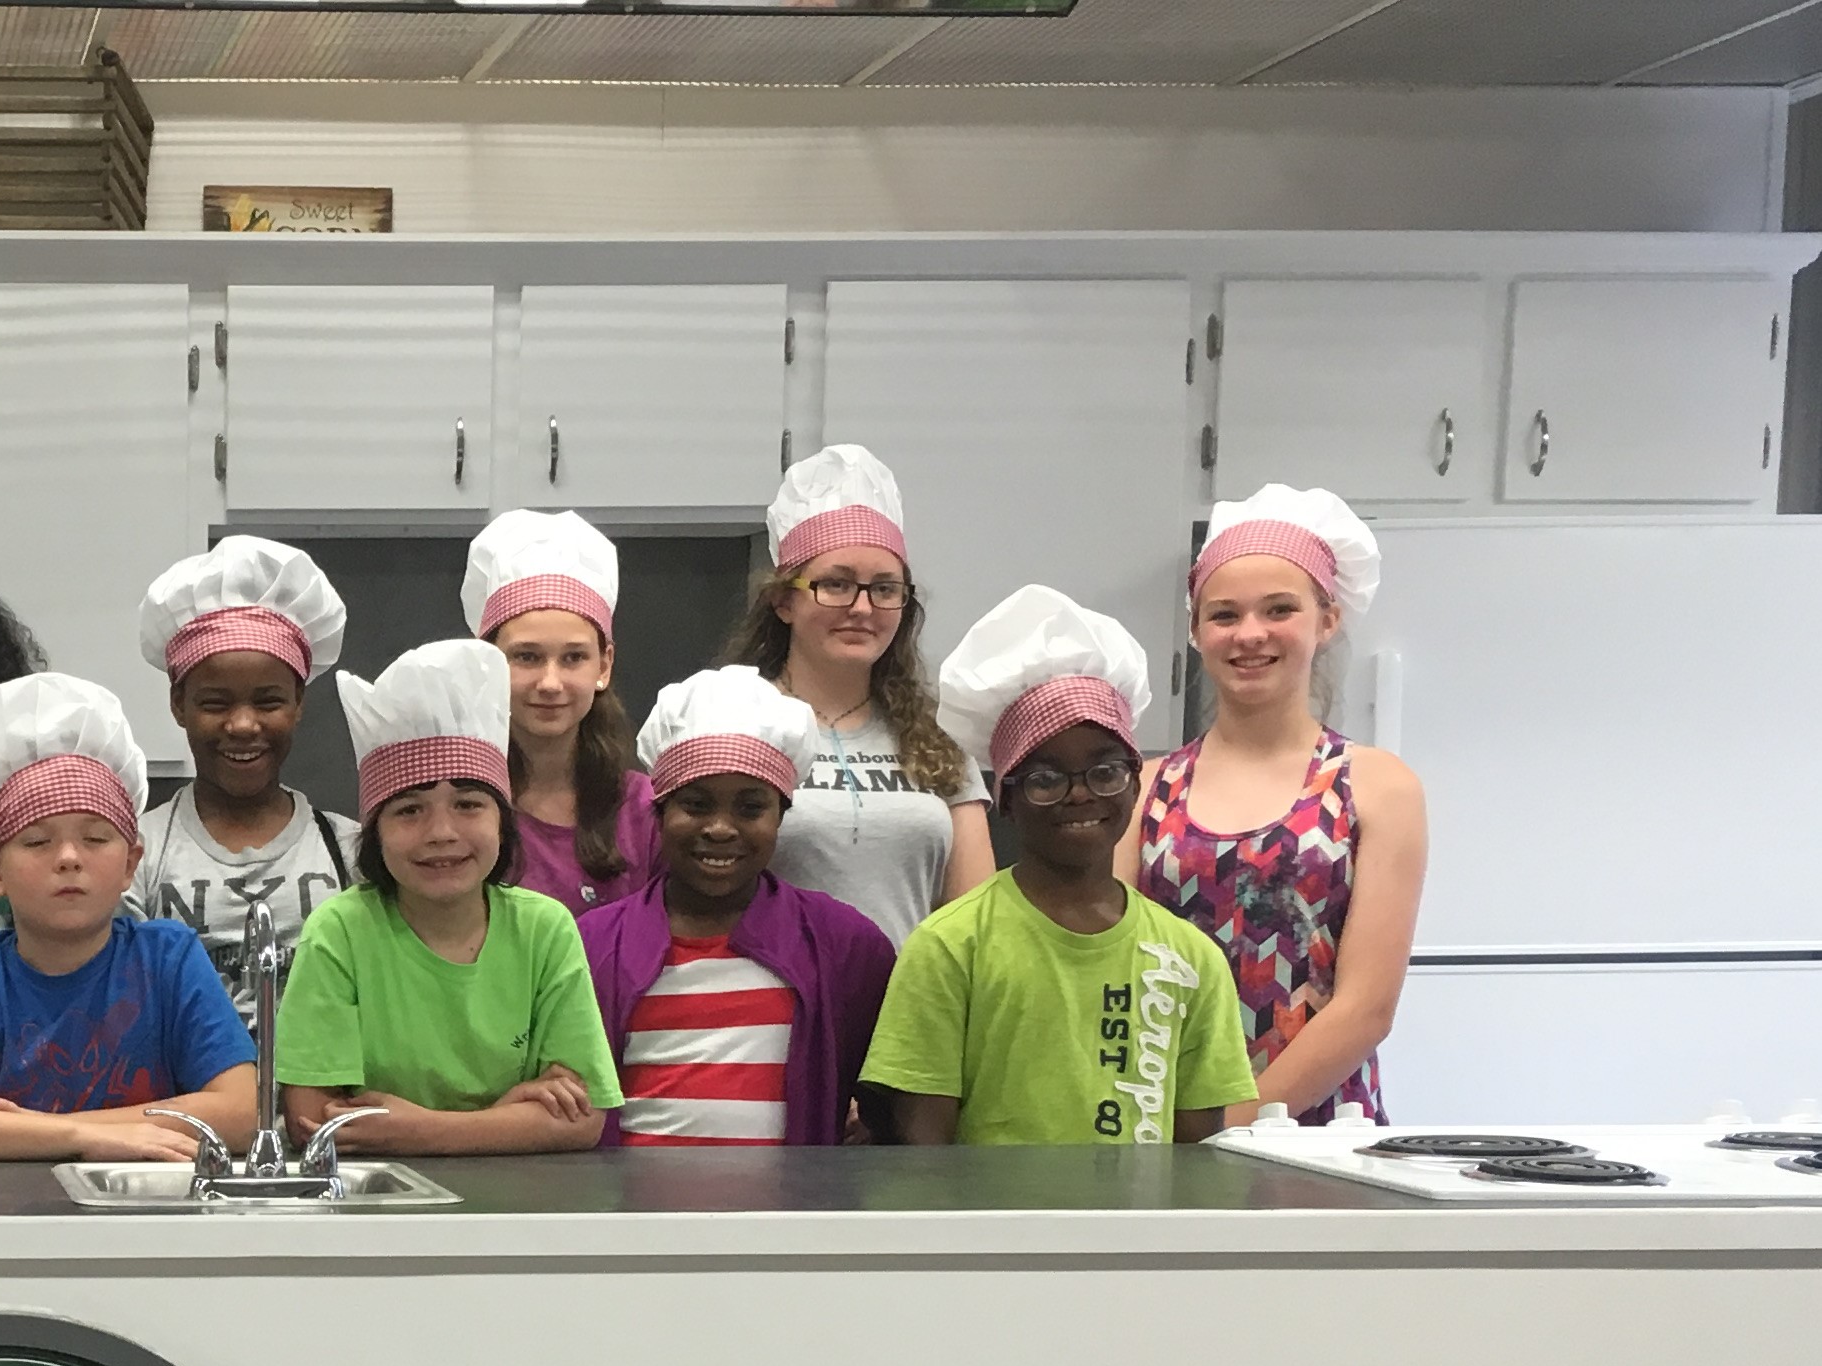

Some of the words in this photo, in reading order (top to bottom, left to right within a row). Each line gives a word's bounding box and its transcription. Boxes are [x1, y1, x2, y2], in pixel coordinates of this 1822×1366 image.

[289, 199, 354, 223] Sweet
[846, 751, 902, 764] abou
[159, 872, 337, 934] NYC
[1099, 983, 1131, 1074] EST
